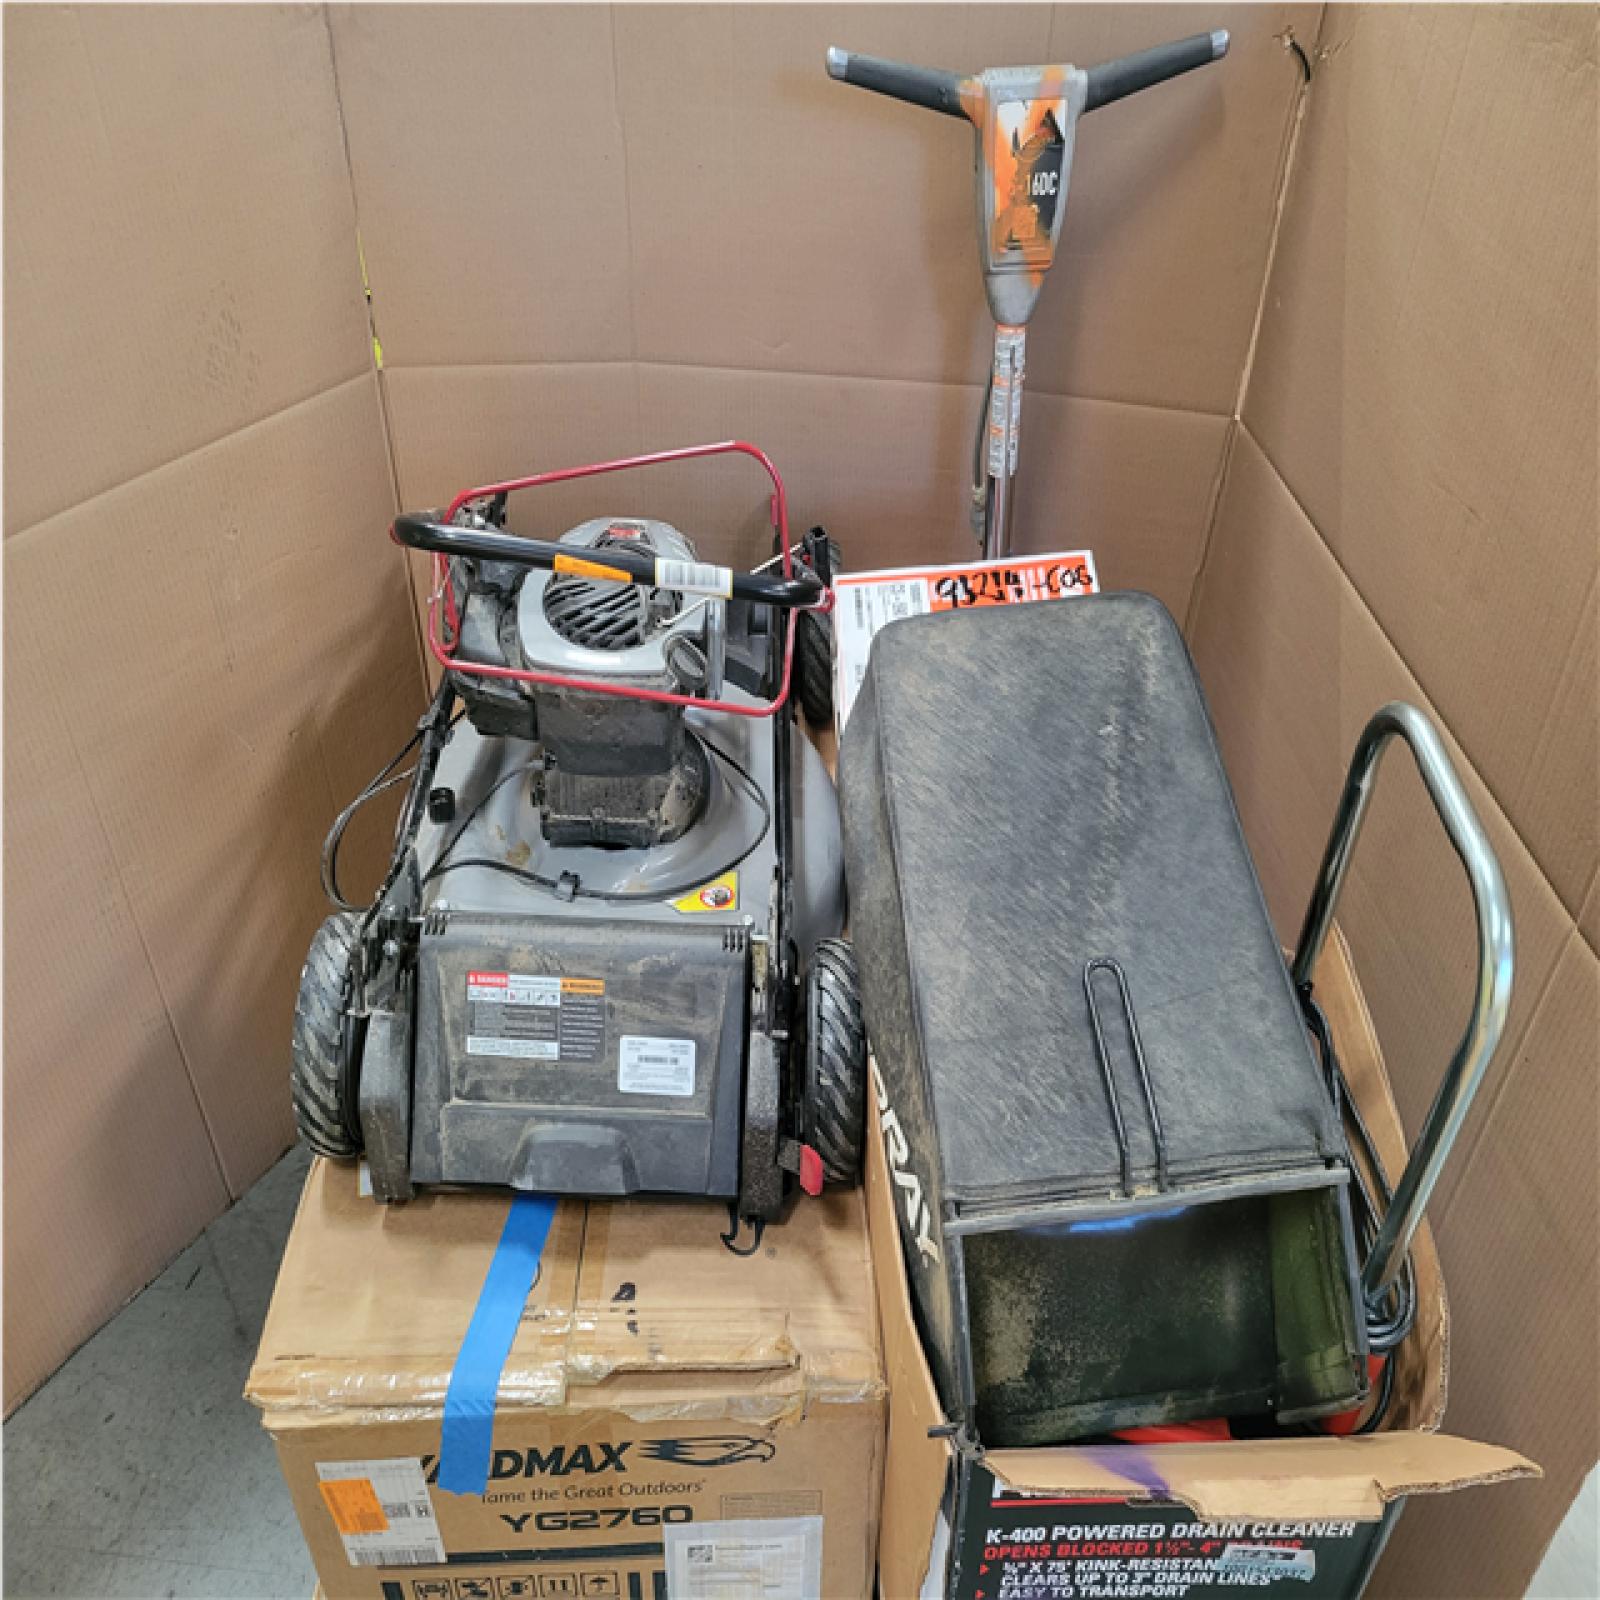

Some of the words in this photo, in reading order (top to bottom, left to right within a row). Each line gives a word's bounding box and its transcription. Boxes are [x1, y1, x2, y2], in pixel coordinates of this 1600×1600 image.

[532, 1486, 560, 1501] the
[564, 1483, 614, 1500] Great
[620, 1480, 703, 1497] Outdoors
[500, 1504, 693, 1533] YG2760
[985, 1527, 1046, 1544] K-400
[1051, 1524, 1166, 1541] POWERED
[1171, 1522, 1246, 1538] DRAIN
[1252, 1521, 1356, 1538] CLEANER
[984, 1543, 1052, 1560] OPENS
[1056, 1541, 1149, 1557] BLOCKED
[1075, 1558, 1219, 1571] KINK-RESISTAN
[1001, 1573, 1071, 1586] CLEARS
[1075, 1572, 1102, 1586] UP
[1104, 1572, 1129, 1585] TO
[1154, 1571, 1215, 1584] DRAIN
[998, 1586, 1047, 1599] EASY
[1051, 1586, 1074, 1598] TO
[1078, 1584, 1190, 1597] TRANSPORT
